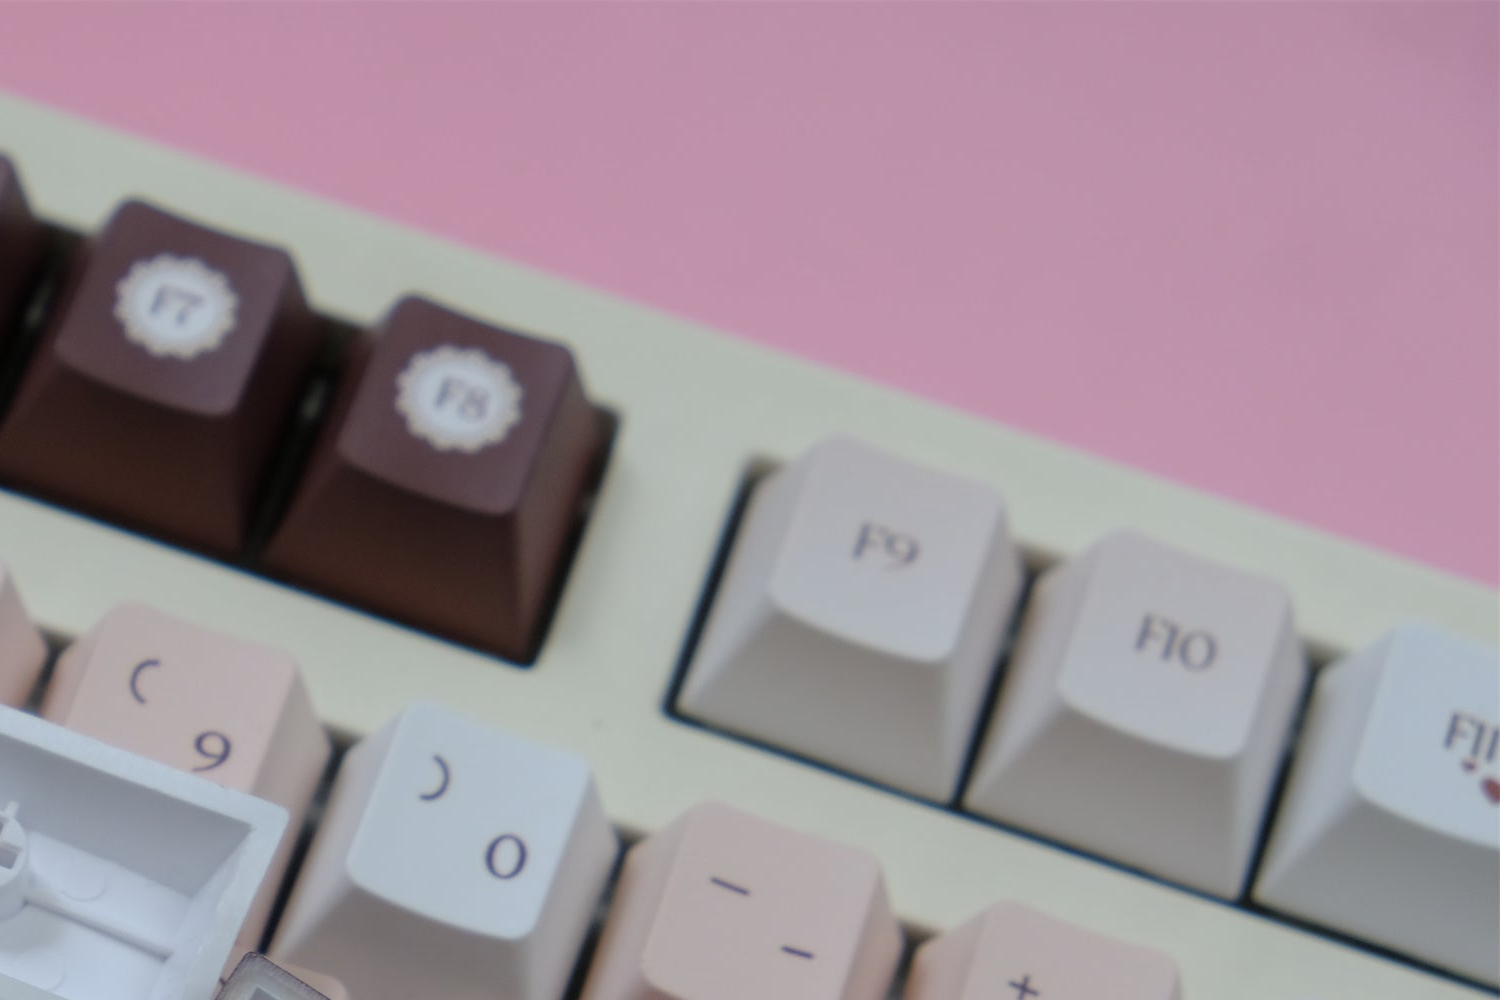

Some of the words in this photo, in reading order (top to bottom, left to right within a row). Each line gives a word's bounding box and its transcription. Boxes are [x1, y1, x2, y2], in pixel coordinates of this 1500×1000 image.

[150, 284, 207, 328] F7
[850, 521, 922, 569] F9
[1133, 613, 1219, 672] F10
[129, 659, 160, 704] (
[192, 731, 232, 773] 9
[420, 755, 450, 801] )
[1009, 976, 1038, 1000] +
